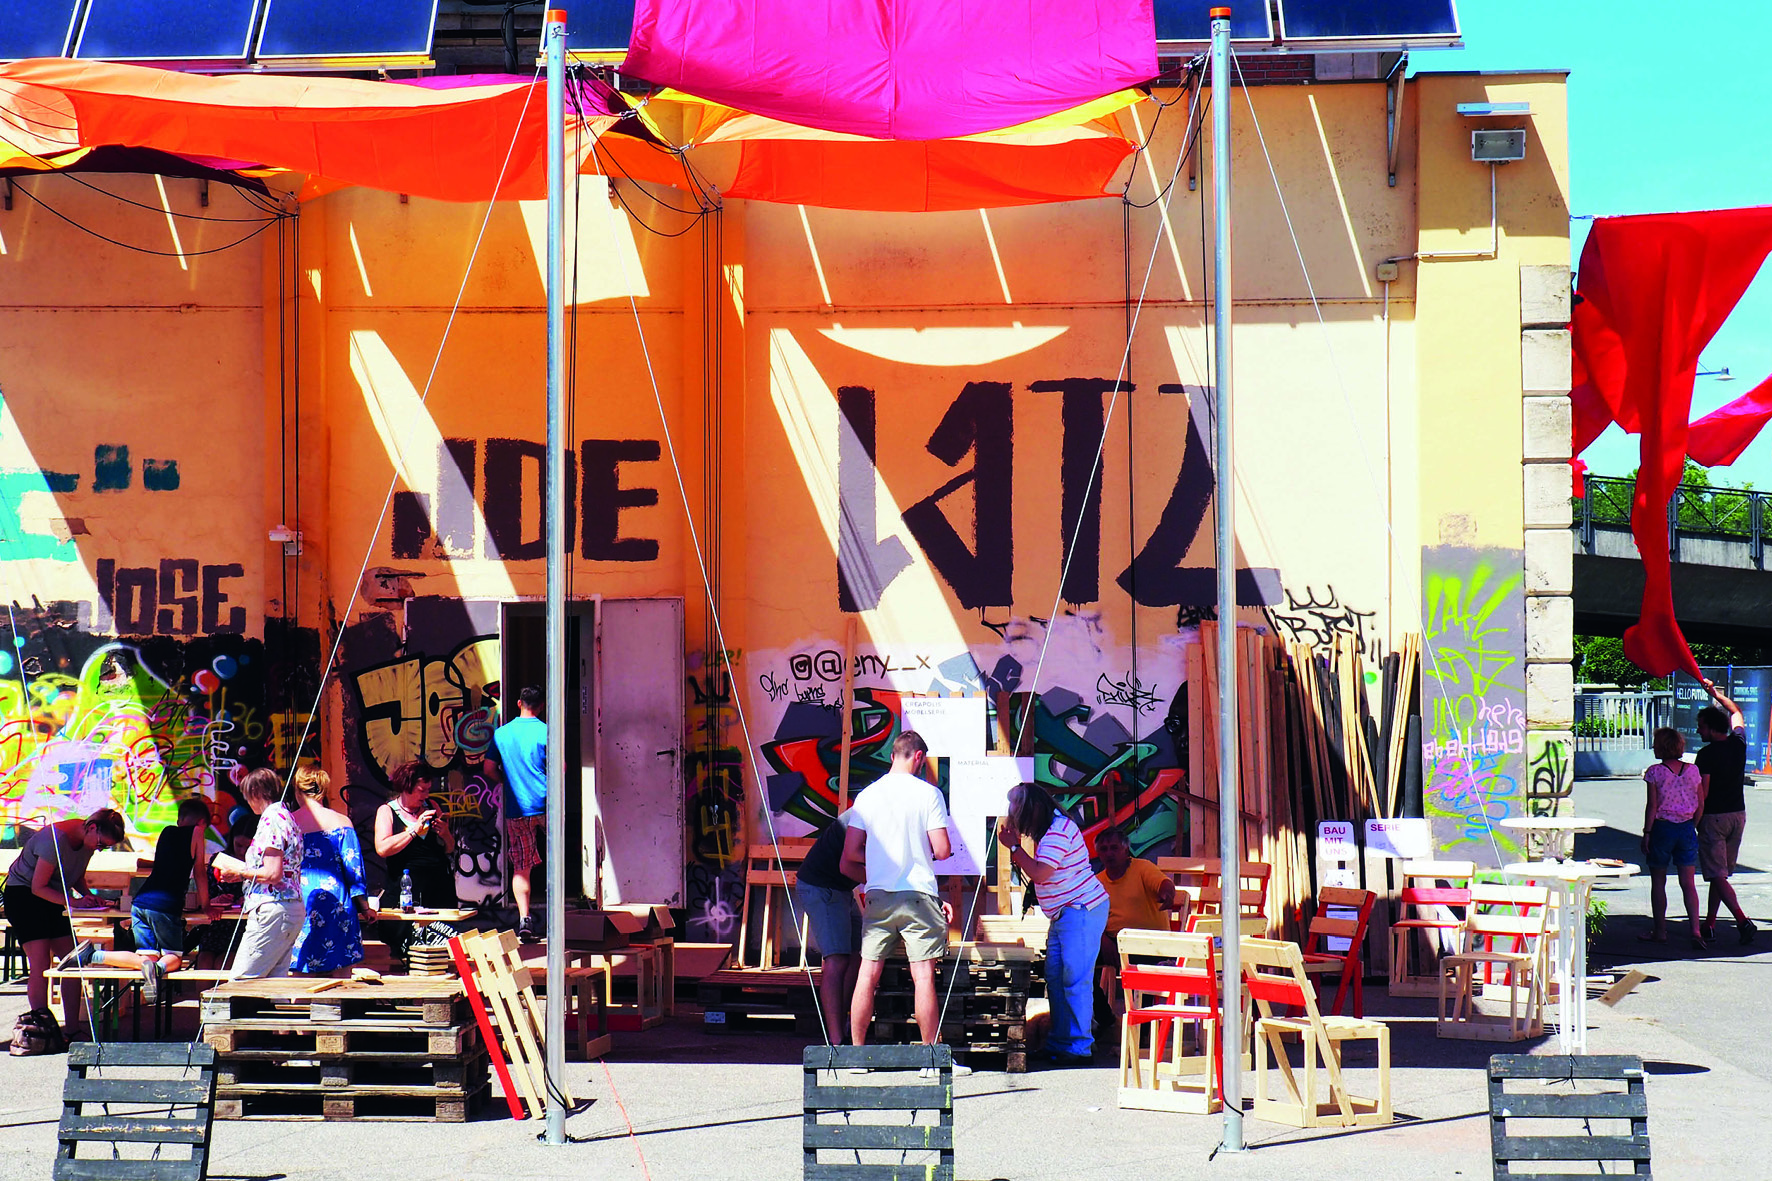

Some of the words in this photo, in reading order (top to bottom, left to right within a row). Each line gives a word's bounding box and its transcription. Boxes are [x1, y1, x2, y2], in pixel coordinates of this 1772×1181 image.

[76, 557, 247, 636] JOSE
[1324, 826, 1346, 835] BAU
[1370, 823, 1401, 832] SERIE
[1324, 837, 1343, 845] MIT
